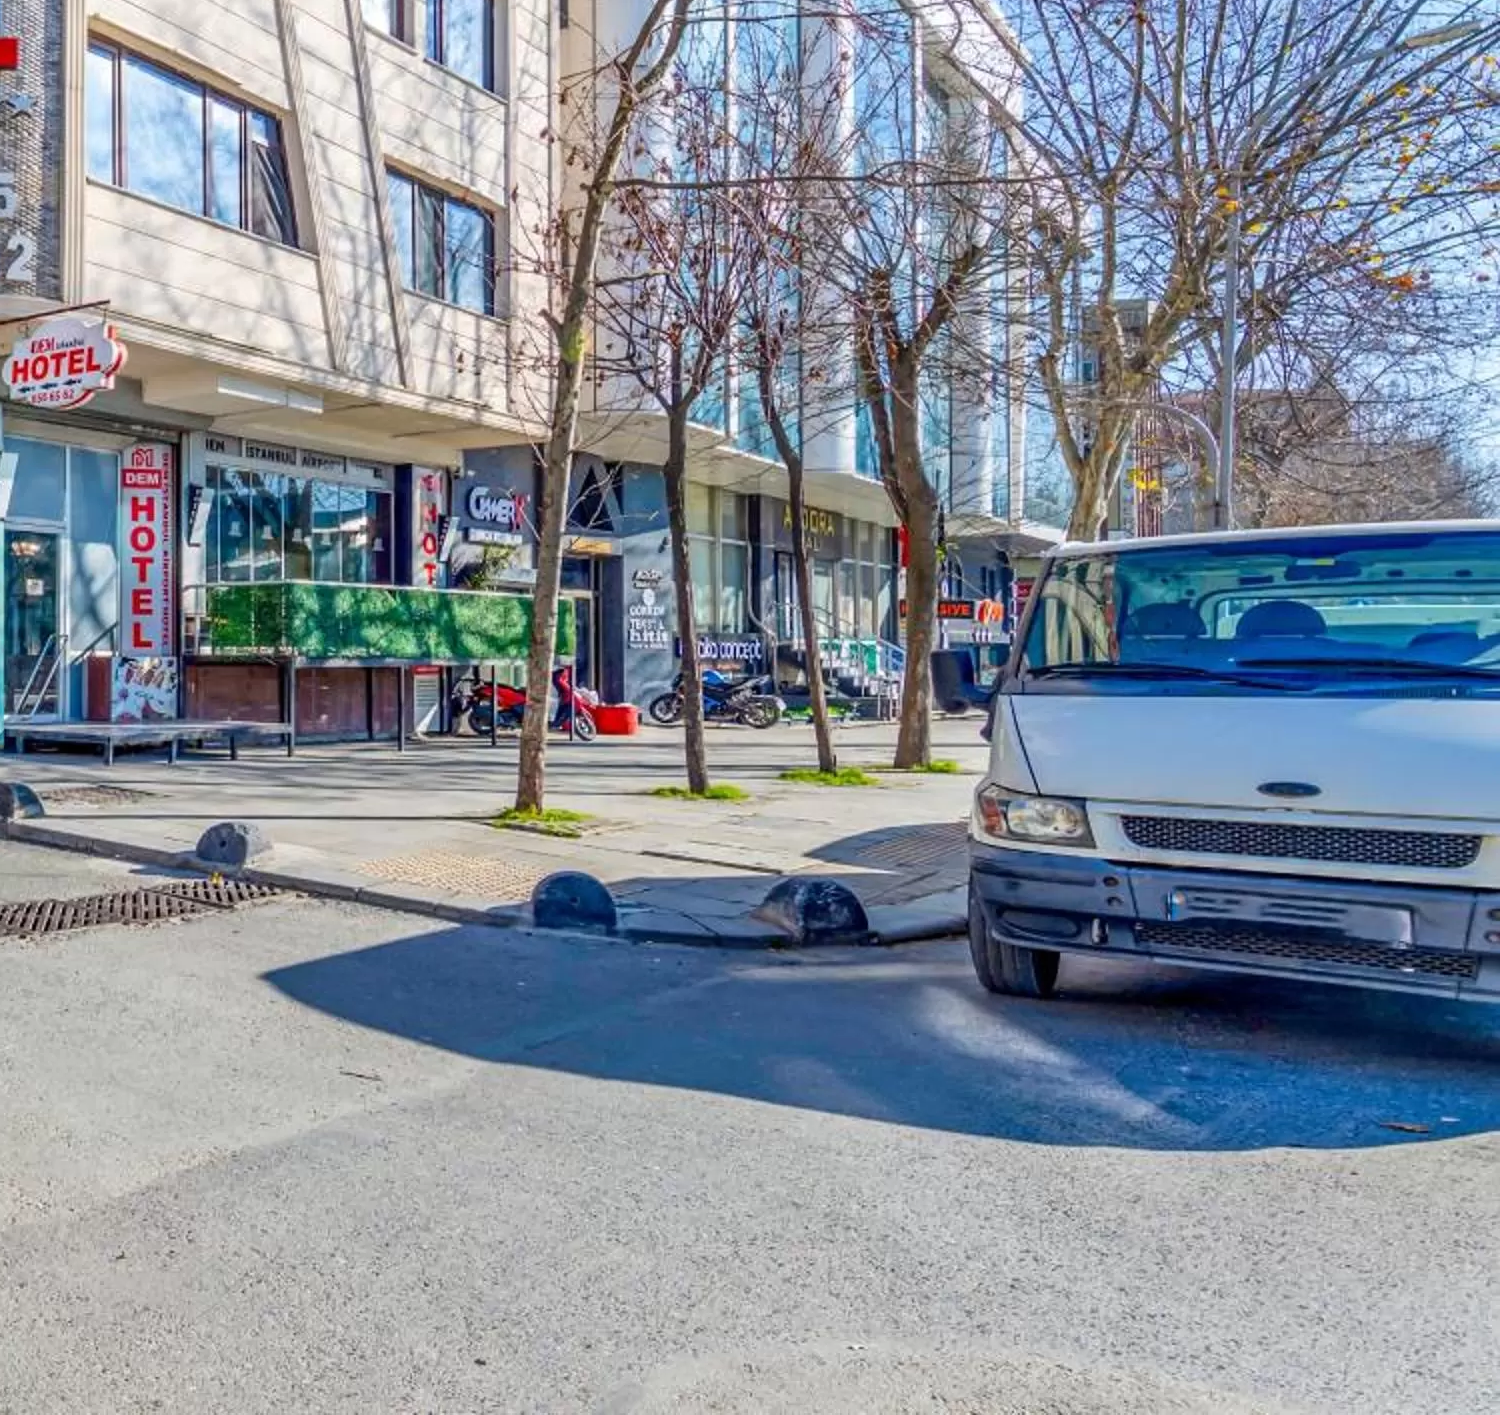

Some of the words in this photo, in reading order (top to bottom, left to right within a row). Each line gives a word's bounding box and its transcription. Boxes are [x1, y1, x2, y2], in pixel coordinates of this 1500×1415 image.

[11, 346, 101, 384] HOTEL
[125, 472, 160, 485] DEM
[130, 496, 156, 649] HOTEL
